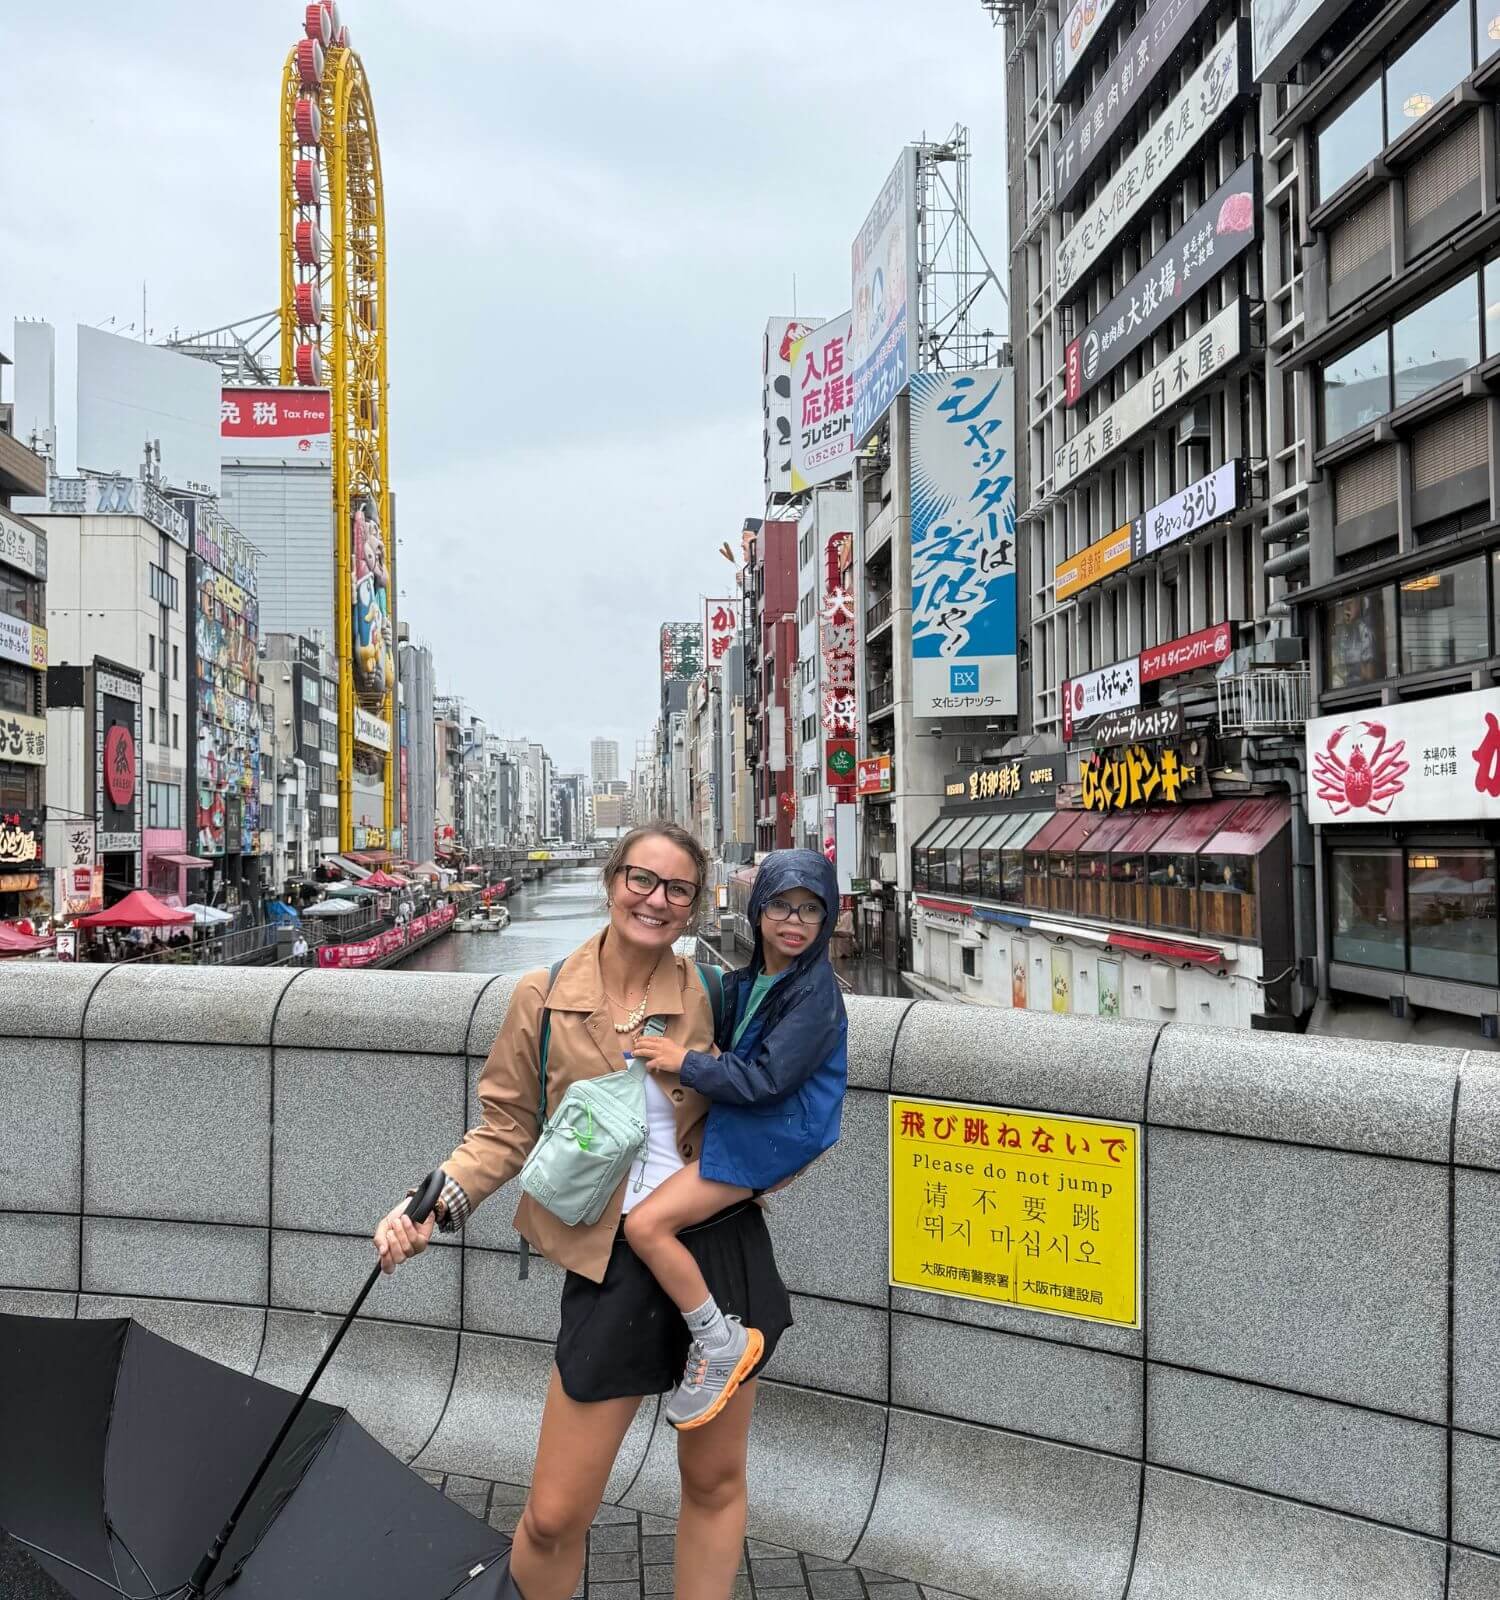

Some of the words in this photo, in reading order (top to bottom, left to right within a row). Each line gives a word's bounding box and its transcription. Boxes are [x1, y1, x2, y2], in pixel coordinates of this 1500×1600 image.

[1056, 139, 1075, 190] 7F
[1081, 98, 1195, 260] 完全個室居酒屋
[1069, 347, 1078, 398] 5F
[1126, 258, 1176, 335] 大牧場
[801, 323, 853, 390] 入店
[220, 401, 278, 425] 免税
[283, 410, 300, 419] Tax
[303, 410, 325, 419] Free
[1056, 448, 1068, 470] 4F
[1068, 415, 1114, 479] 白木屋
[1152, 332, 1215, 414] 白木屋
[1135, 519, 1142, 556] 3F
[954, 672, 976, 686] BX
[1064, 691, 1072, 732] 2F
[1097, 711, 1179, 742] ハンバーグレストラン
[1423, 746, 1457, 762] 本場の味
[1423, 762, 1458, 777] かに料理
[969, 763, 1021, 800] 星乃珈琲店
[1029, 768, 1053, 784] COFFEE
[1080, 744, 1196, 811] びっくりドンキー
[900, 1111, 1128, 1163] 飛び跳ねないで
[913, 1153, 975, 1176] Please
[983, 1163, 1007, 1179] do
[1016, 1168, 1049, 1186] not
[1057, 1172, 1113, 1198] jump
[923, 1181, 1100, 1232] 请不要跳
[923, 1214, 972, 1248] 뛰지
[990, 1224, 1102, 1265] 마십시오
[920, 1261, 1009, 1289] 大阪府南警察署
[1022, 1279, 1103, 1305] 大阪市建設局
